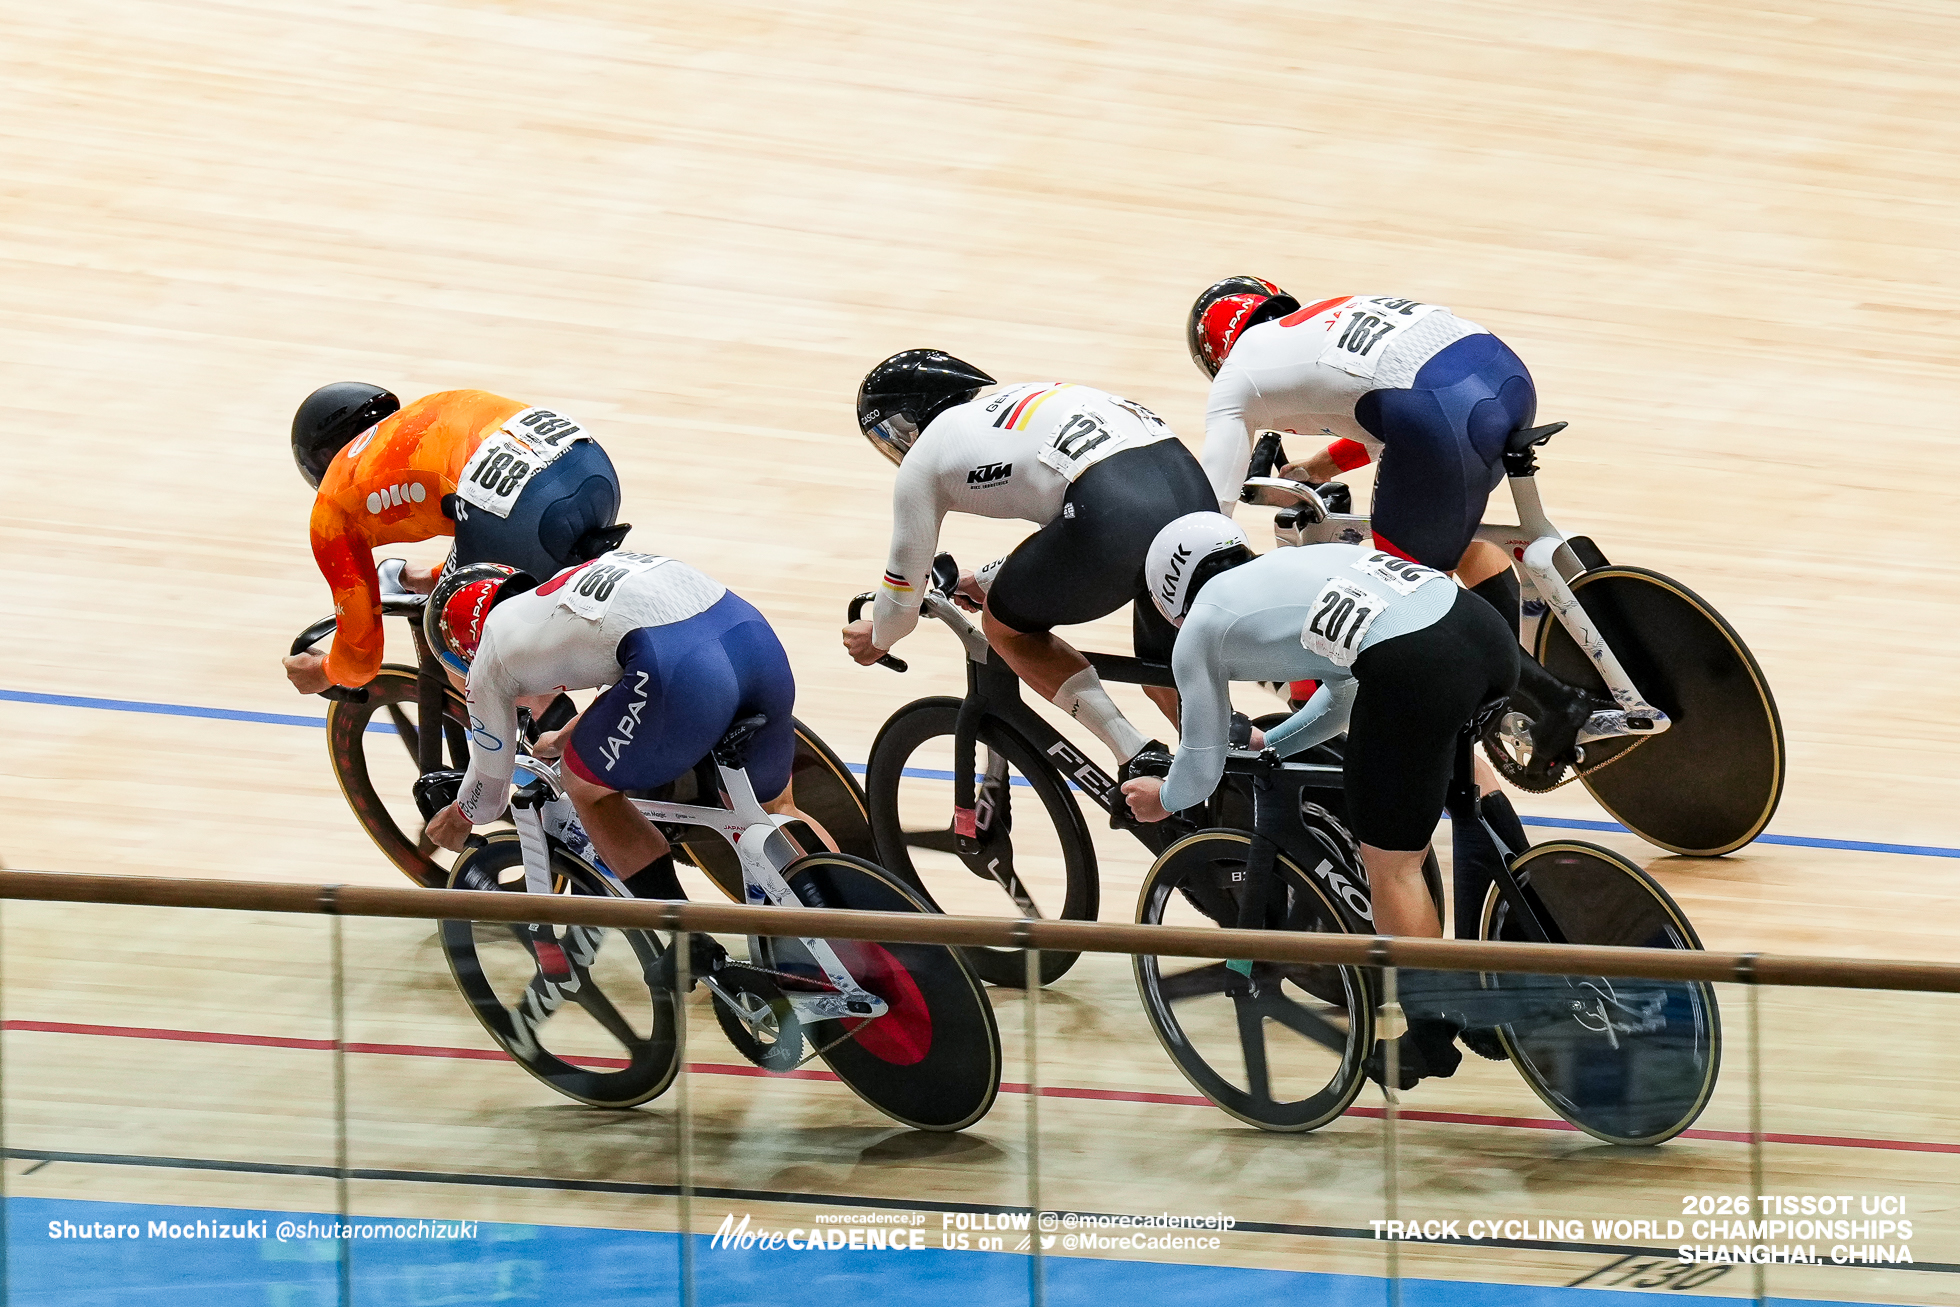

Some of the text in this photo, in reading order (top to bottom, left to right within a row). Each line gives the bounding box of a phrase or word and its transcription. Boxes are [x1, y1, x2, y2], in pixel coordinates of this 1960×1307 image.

[1220, 297, 1254, 351] JAPAN
[1337, 311, 1396, 357] 167
[861, 408, 881, 427] CASCO
[1053, 413, 1111, 462] 127
[469, 446, 530, 498] 188
[966, 462, 1013, 483] KTM
[572, 563, 630, 603] 168
[1161, 542, 1192, 605] KASK
[469, 583, 492, 641] JAPAN
[1309, 590, 1372, 650] 201
[599, 670, 649, 772] JAPAN
